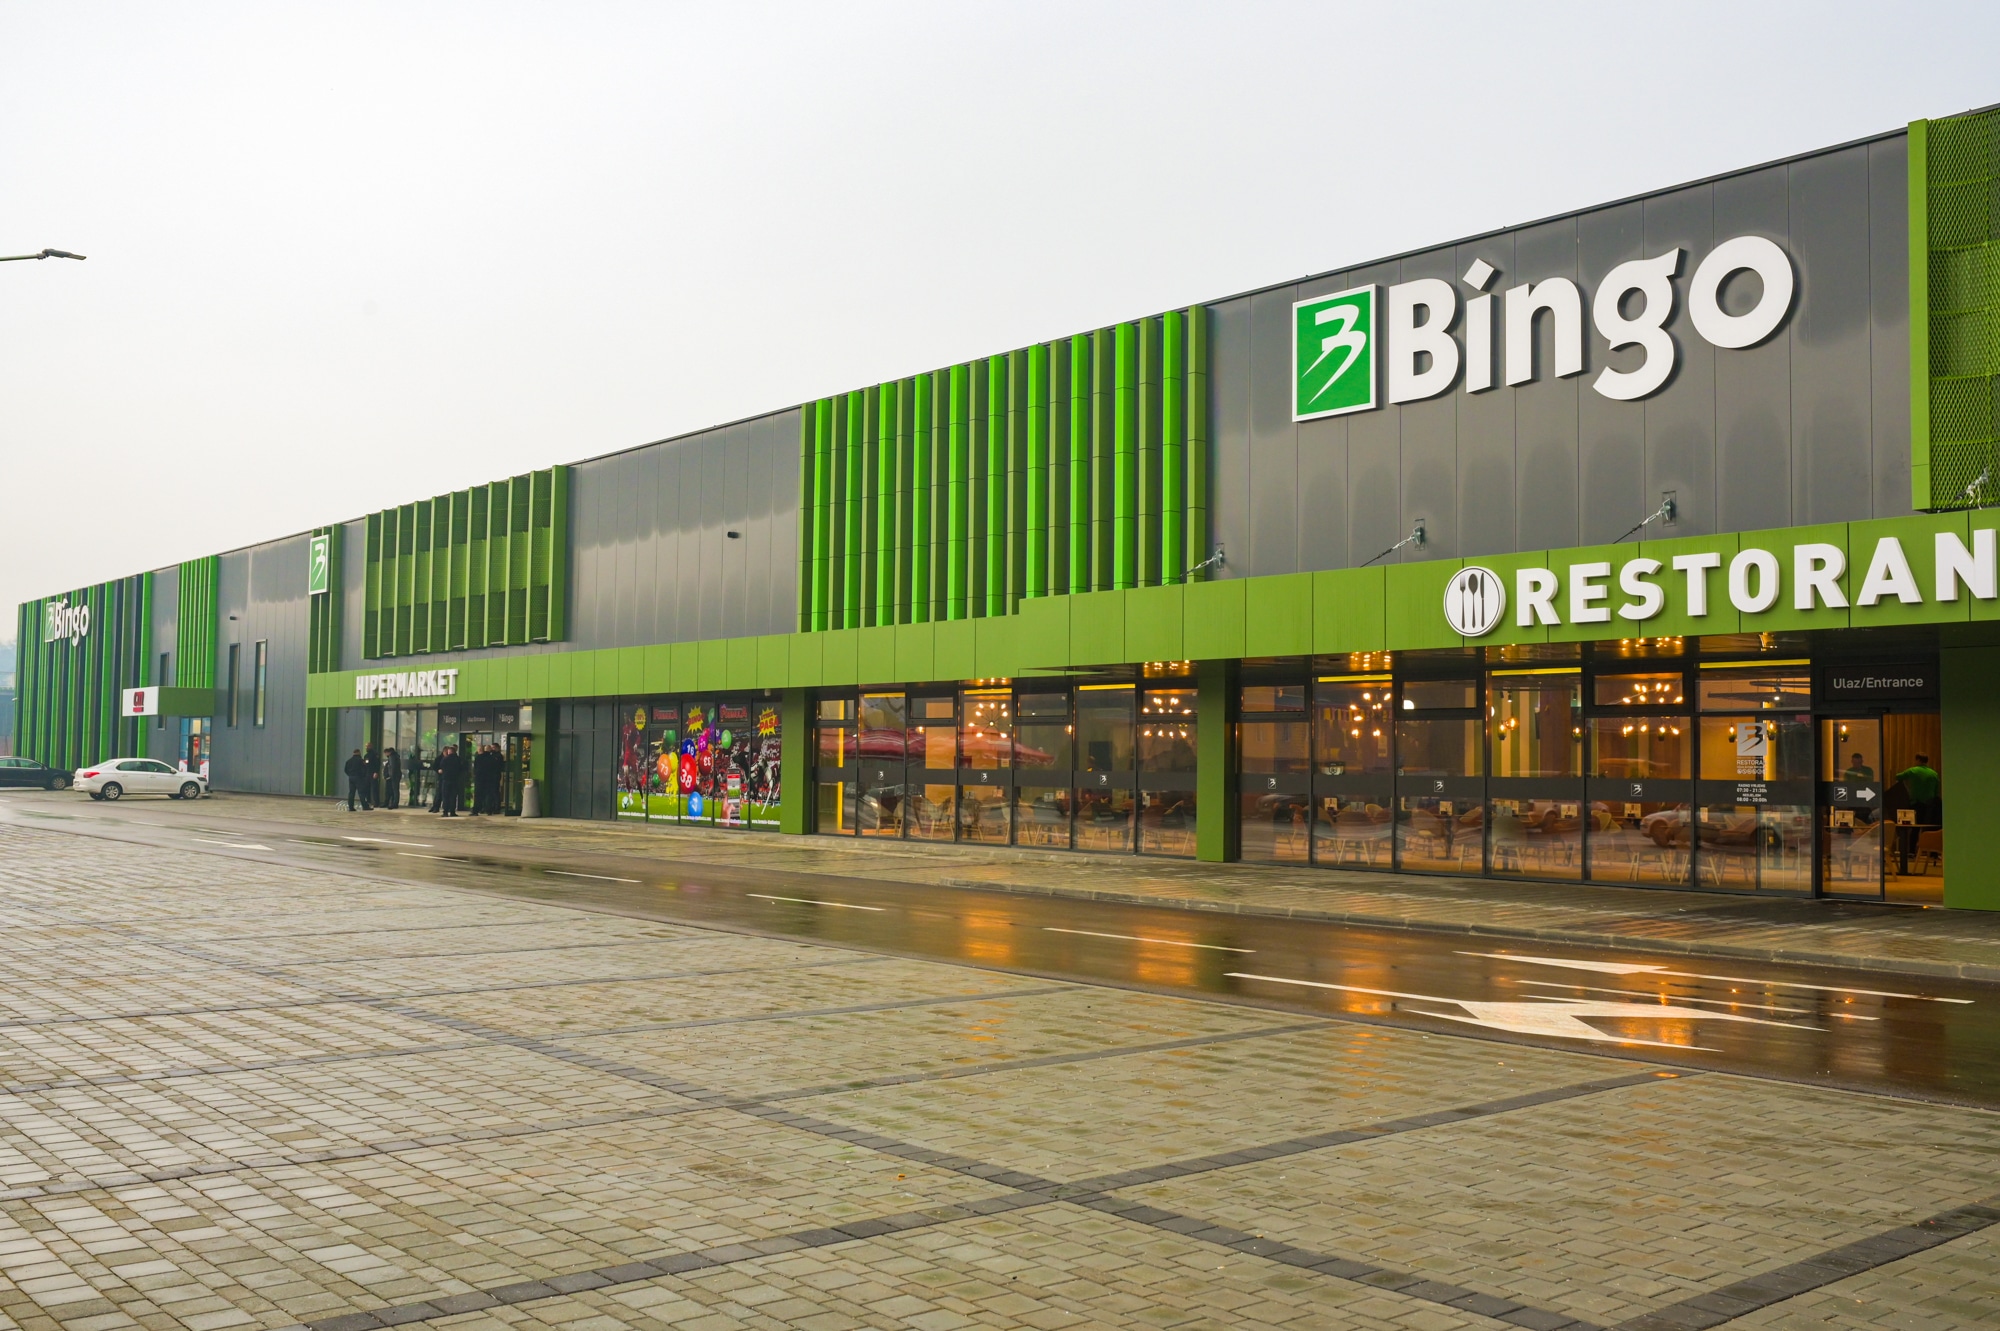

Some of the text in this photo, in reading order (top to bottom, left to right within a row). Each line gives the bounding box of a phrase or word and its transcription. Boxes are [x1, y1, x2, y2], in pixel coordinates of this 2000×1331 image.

[1389, 235, 1794, 404] Bingo
[1516, 528, 1997, 626] RESTORAN
[54, 598, 89, 647] Bingo
[356, 668, 458, 700] HIPERMARKET
[1833, 677, 1924, 689] Ulaz/Entrance
[687, 744, 695, 756] 16
[660, 763, 669, 776] 73
[680, 768, 692, 788] 38
